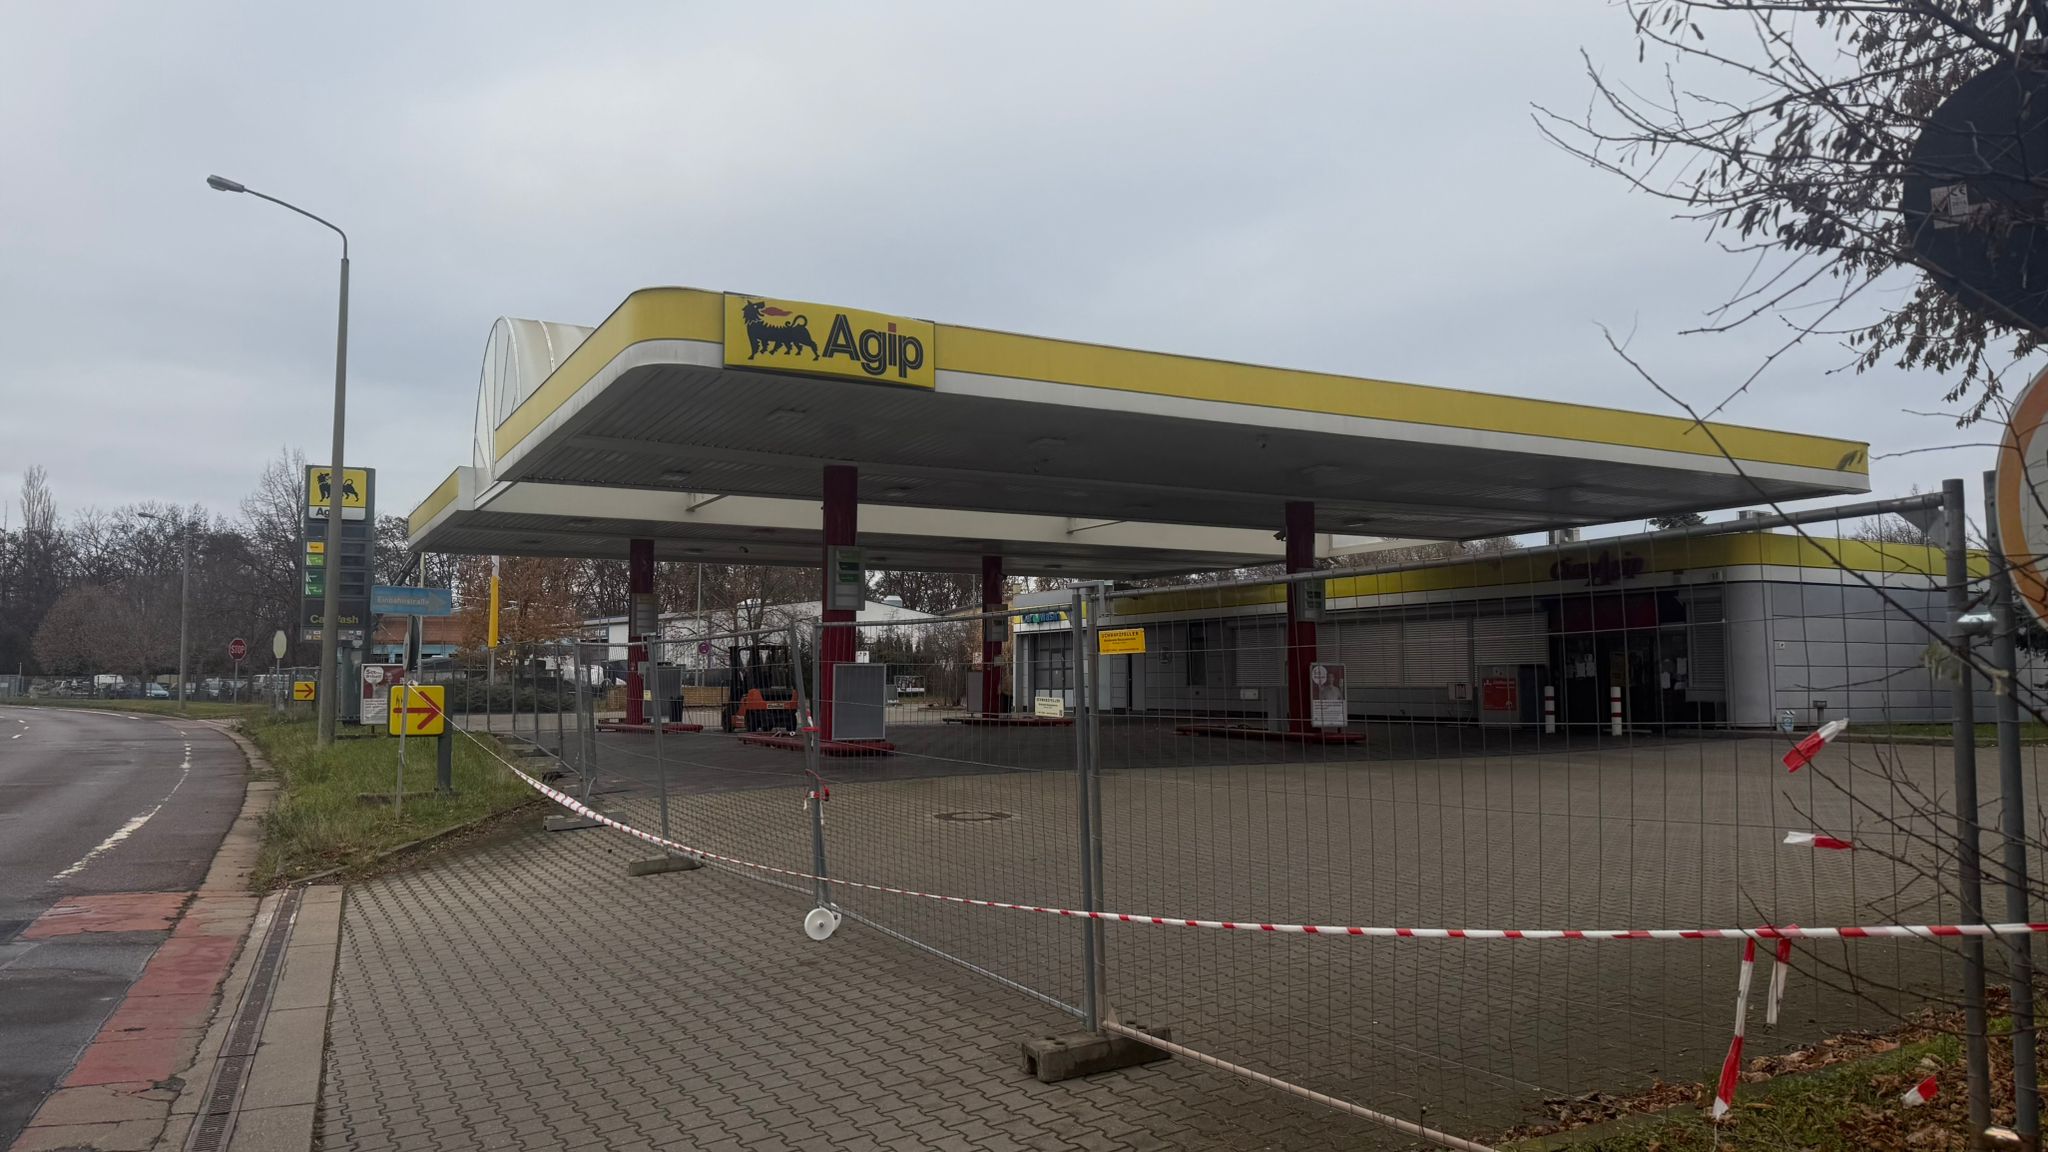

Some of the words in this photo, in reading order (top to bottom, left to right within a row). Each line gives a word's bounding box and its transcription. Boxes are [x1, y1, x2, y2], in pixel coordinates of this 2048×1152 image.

[822, 313, 924, 378] Agip
[315, 507, 330, 519] Ag
[230, 645, 246, 654] STOP
